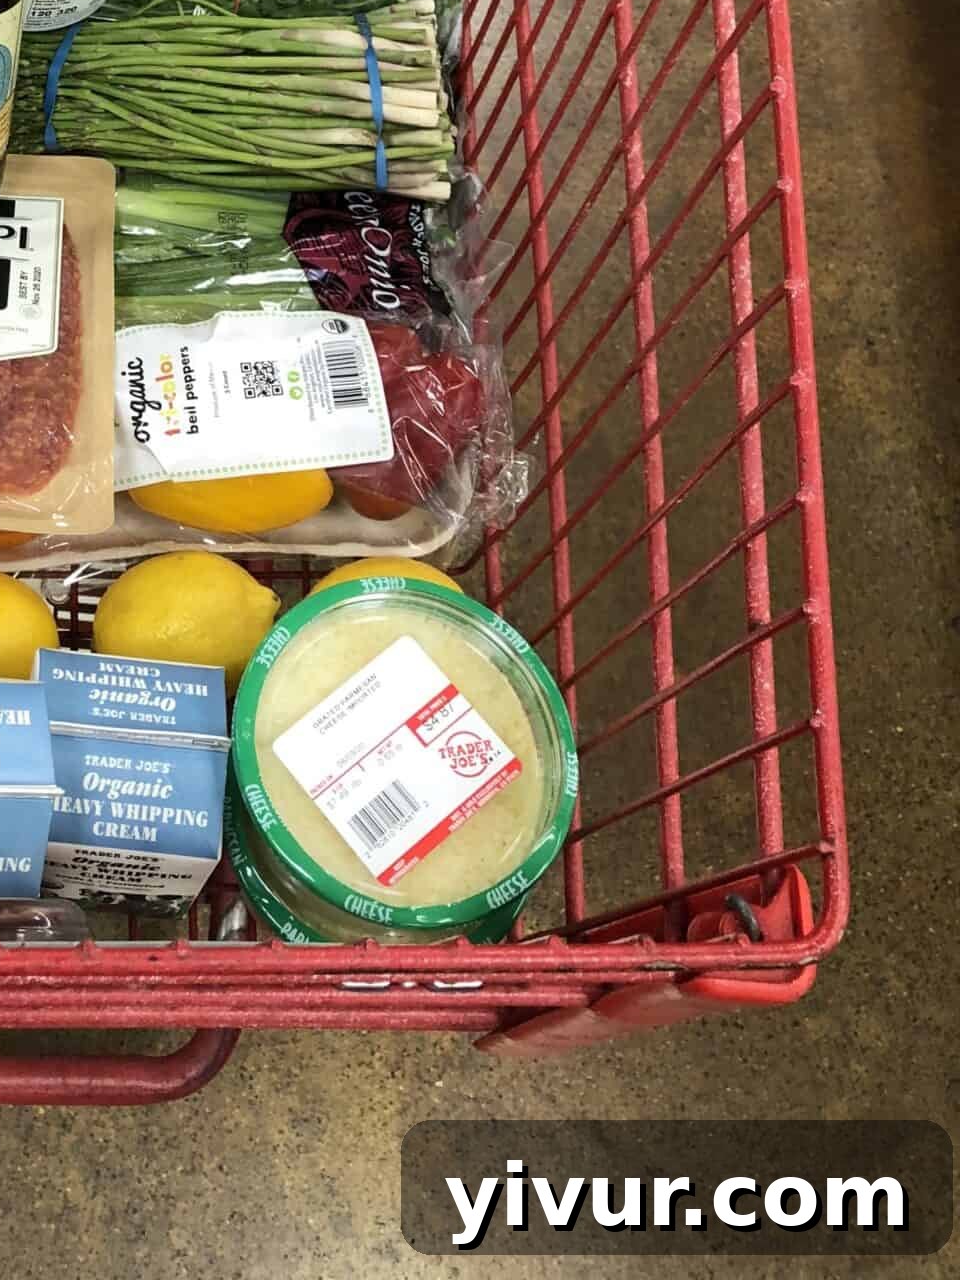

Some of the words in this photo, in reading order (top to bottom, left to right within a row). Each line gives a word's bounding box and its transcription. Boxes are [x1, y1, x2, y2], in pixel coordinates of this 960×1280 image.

[180, 346, 198, 402] peppers
[121, 356, 162, 443] organic
[183, 403, 199, 435] bell
[360, 576, 407, 593] CHEESE
[489, 616, 531, 654] CHEESE
[256, 627, 291, 668] CHEESE
[53, 668, 150, 690] WHIPPING
[99, 662, 160, 677] CREAM
[155, 680, 208, 697] HEAVY
[89, 689, 177, 711] Organic
[92, 707, 126, 719] JOE'S
[130, 711, 176, 725] TRADER
[438, 739, 493, 759] TRADER
[84, 755, 131, 770] TRADER
[135, 760, 171, 773] JOE'S
[449, 752, 489, 770] JOE'S
[565, 750, 579, 798] CHEESE
[82, 772, 173, 799] Organic
[111, 803, 208, 828] WHIPPING
[244, 783, 276, 833] CHEESE
[93, 822, 158, 842] CREAM
[72, 857, 161, 871] Organic
[74, 849, 121, 858] TRADER
[125, 852, 160, 862] JOE'S
[46, 861, 90, 871] EAVY
[97, 868, 193, 880] WHIPPING
[80, 872, 142, 883] CREAM
[486, 872, 531, 908] CHEESE
[344, 895, 394, 924] CHEESE
